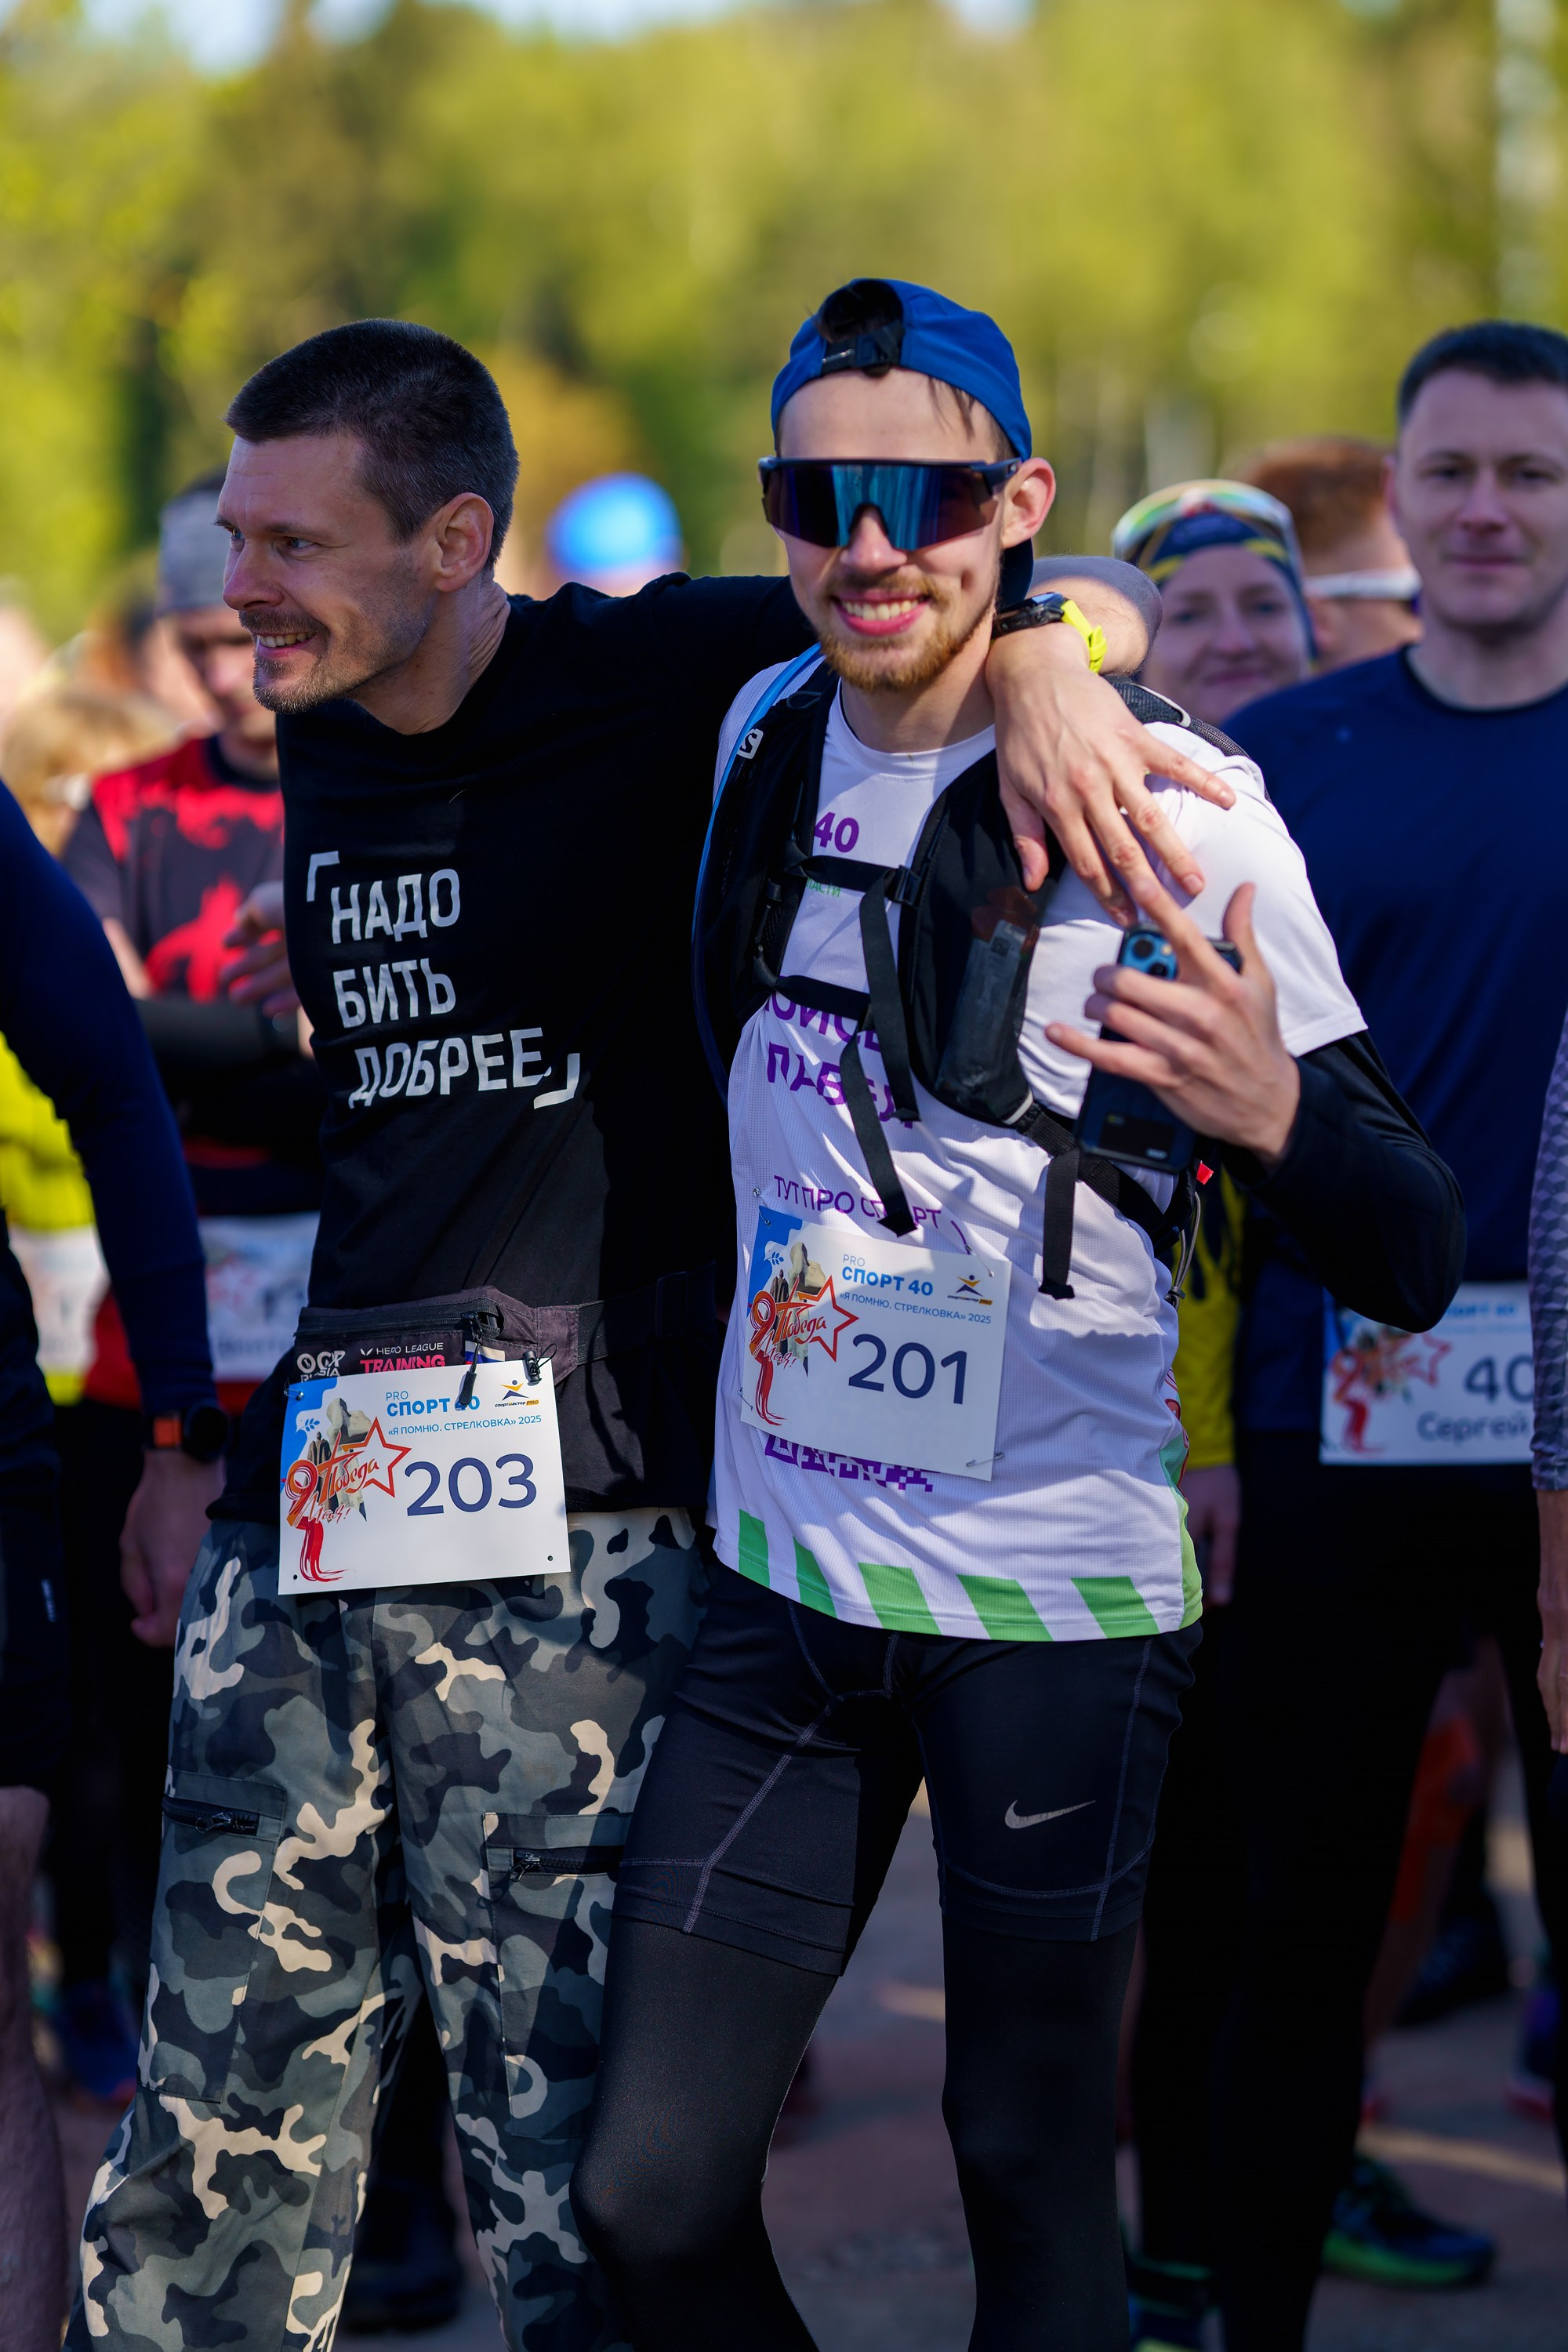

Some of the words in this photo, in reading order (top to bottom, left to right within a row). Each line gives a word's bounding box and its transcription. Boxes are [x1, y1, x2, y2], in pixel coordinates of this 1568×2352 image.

[814, 811, 859, 853] 40
[330, 869, 460, 944] НАДО
[333, 958, 456, 1029] БИТЬ
[349, 1028, 550, 1109] ДОБРЕЕ
[774, 1175, 799, 1204] ТУТ
[802, 1187, 855, 1214] ПРО
[861, 1196, 941, 1229] СПРТ
[843, 1254, 865, 1267] PRO
[842, 1266, 905, 1291] СПОРТ
[909, 1279, 933, 1296] 40
[851, 1294, 891, 1309] ПОМНЮ.
[894, 1302, 966, 1320] СТРЕЛКОВКА»
[968, 1313, 992, 1324] 2025
[376, 1345, 401, 1355] HERO
[405, 1342, 444, 1353] LEAGUE
[360, 1354, 445, 1374] TRAINING
[848, 1334, 967, 1405] 201
[386, 1391, 408, 1401] PRO
[387, 1398, 451, 1417] СПОРТ
[401, 1424, 442, 1435] ПОМНЮ.
[444, 1417, 516, 1431] СТРЕЛКОВКА»
[519, 1415, 542, 1425] 2025
[405, 1454, 537, 1516] 203
